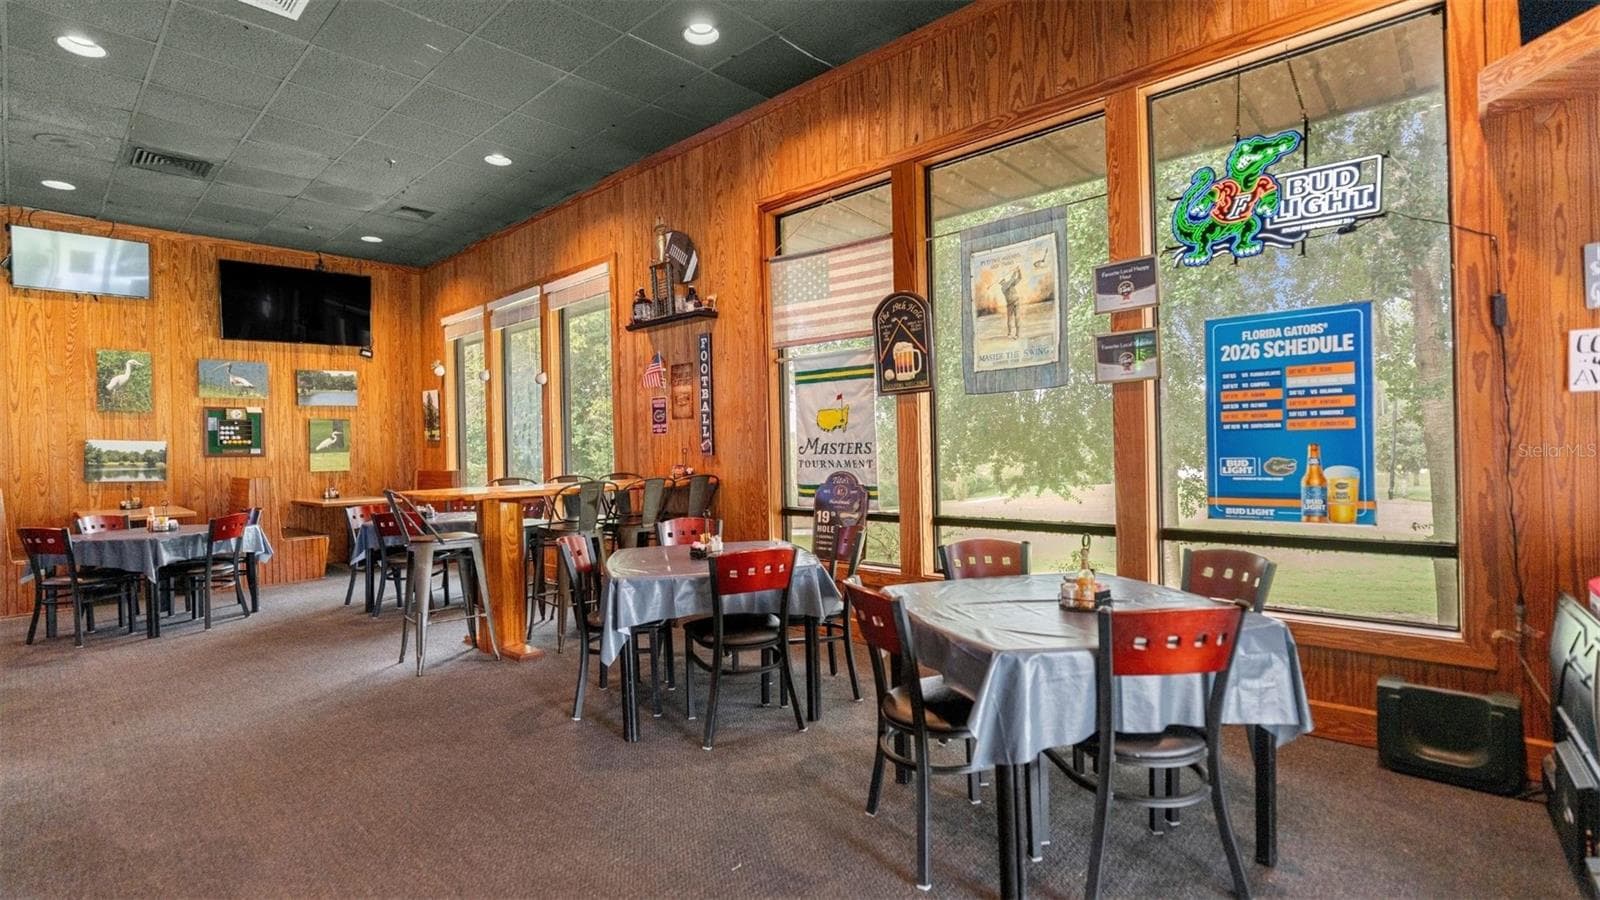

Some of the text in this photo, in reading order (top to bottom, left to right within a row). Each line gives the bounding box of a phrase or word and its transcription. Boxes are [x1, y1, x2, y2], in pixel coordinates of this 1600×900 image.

[1286, 166, 1360, 200] BUD
[1275, 184, 1375, 220] LIGHT
[1241, 328, 1282, 341] FLORIDA
[1220, 333, 1355, 362] 2026 SCHEDULE
[700, 337, 710, 437] FOOTBALL
[798, 459, 874, 469] TOURNAMENT
[1226, 459, 1249, 467] BUD
[1222, 466, 1254, 474] LIGHT
[1225, 507, 1275, 516] BUD LIGHT
[816, 525, 834, 533] HOLE
